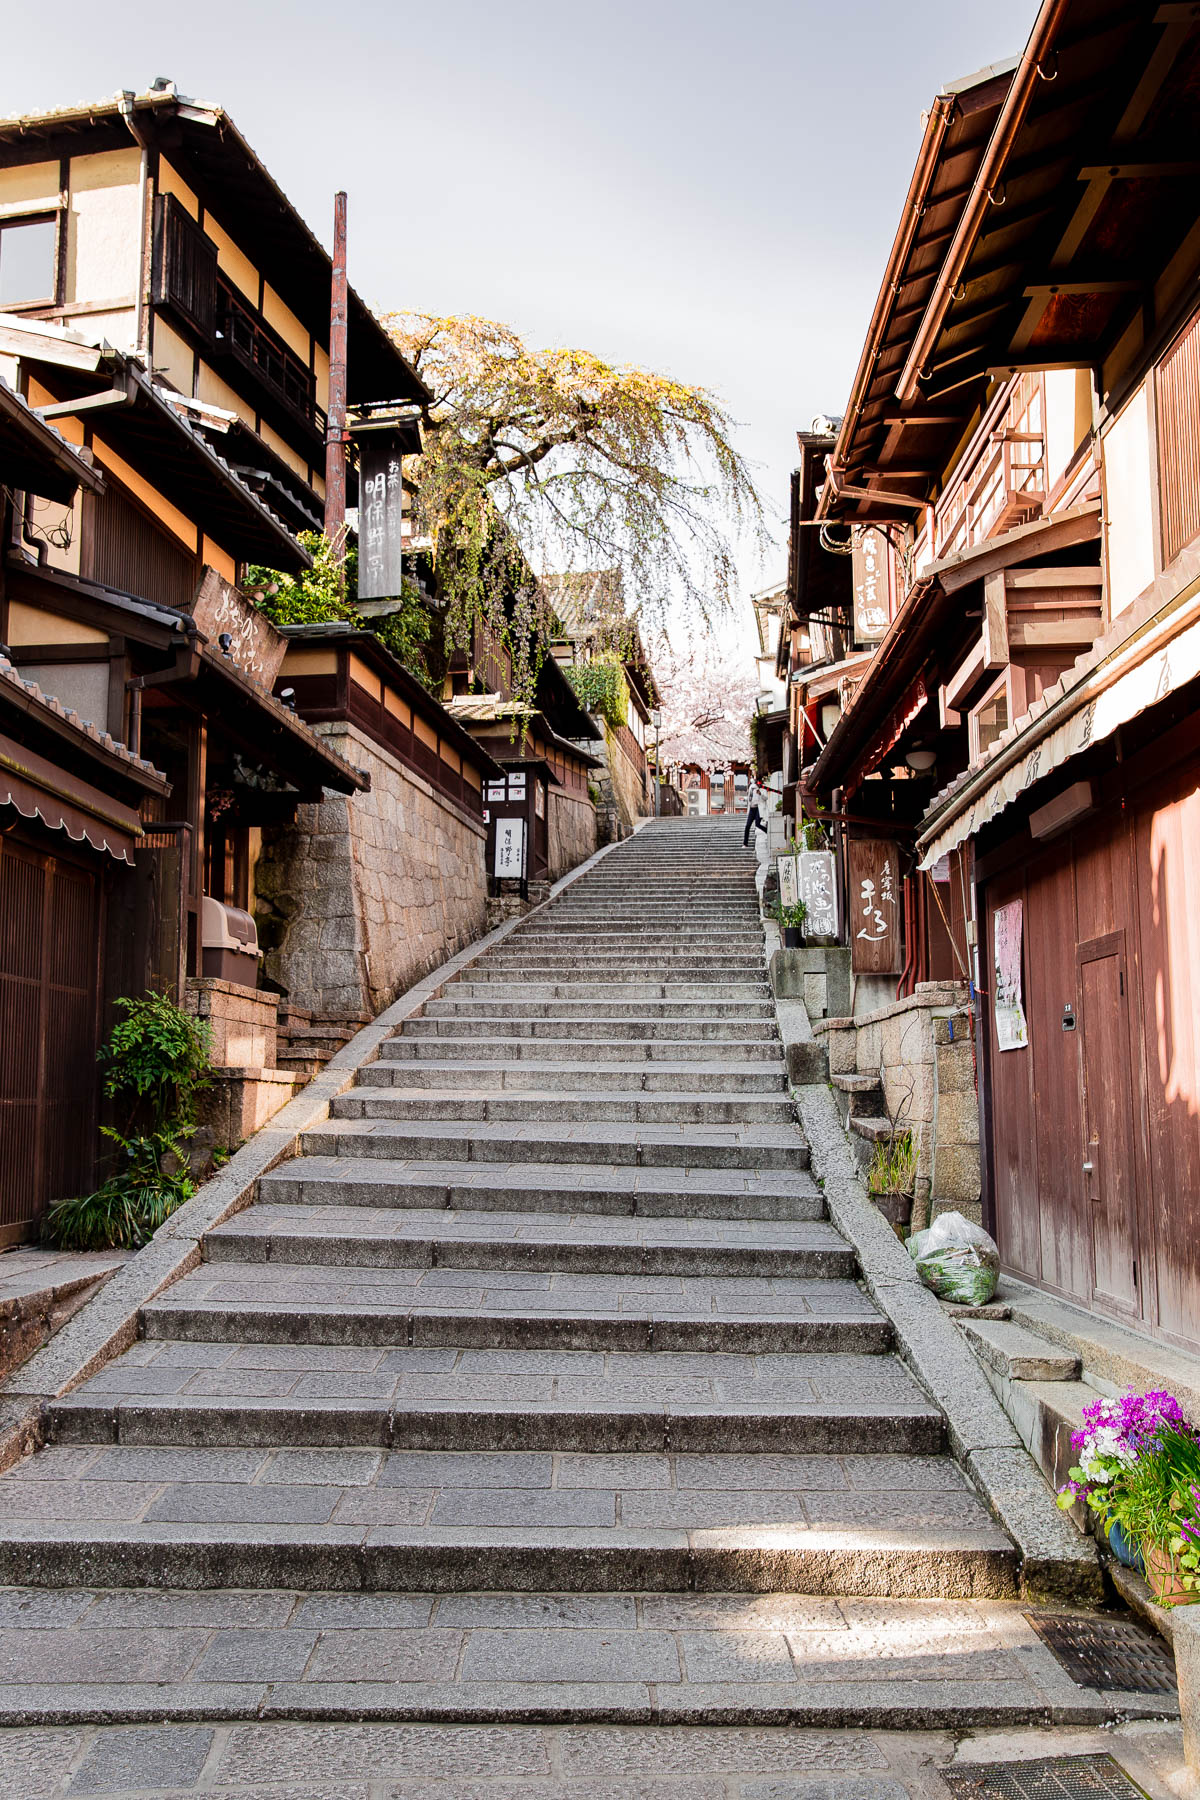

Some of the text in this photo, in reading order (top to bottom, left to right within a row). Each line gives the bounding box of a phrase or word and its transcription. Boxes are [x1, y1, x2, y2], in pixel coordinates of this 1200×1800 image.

[365, 472, 386, 577] 明保野亭
[880, 859, 896, 904] 産寧坂
